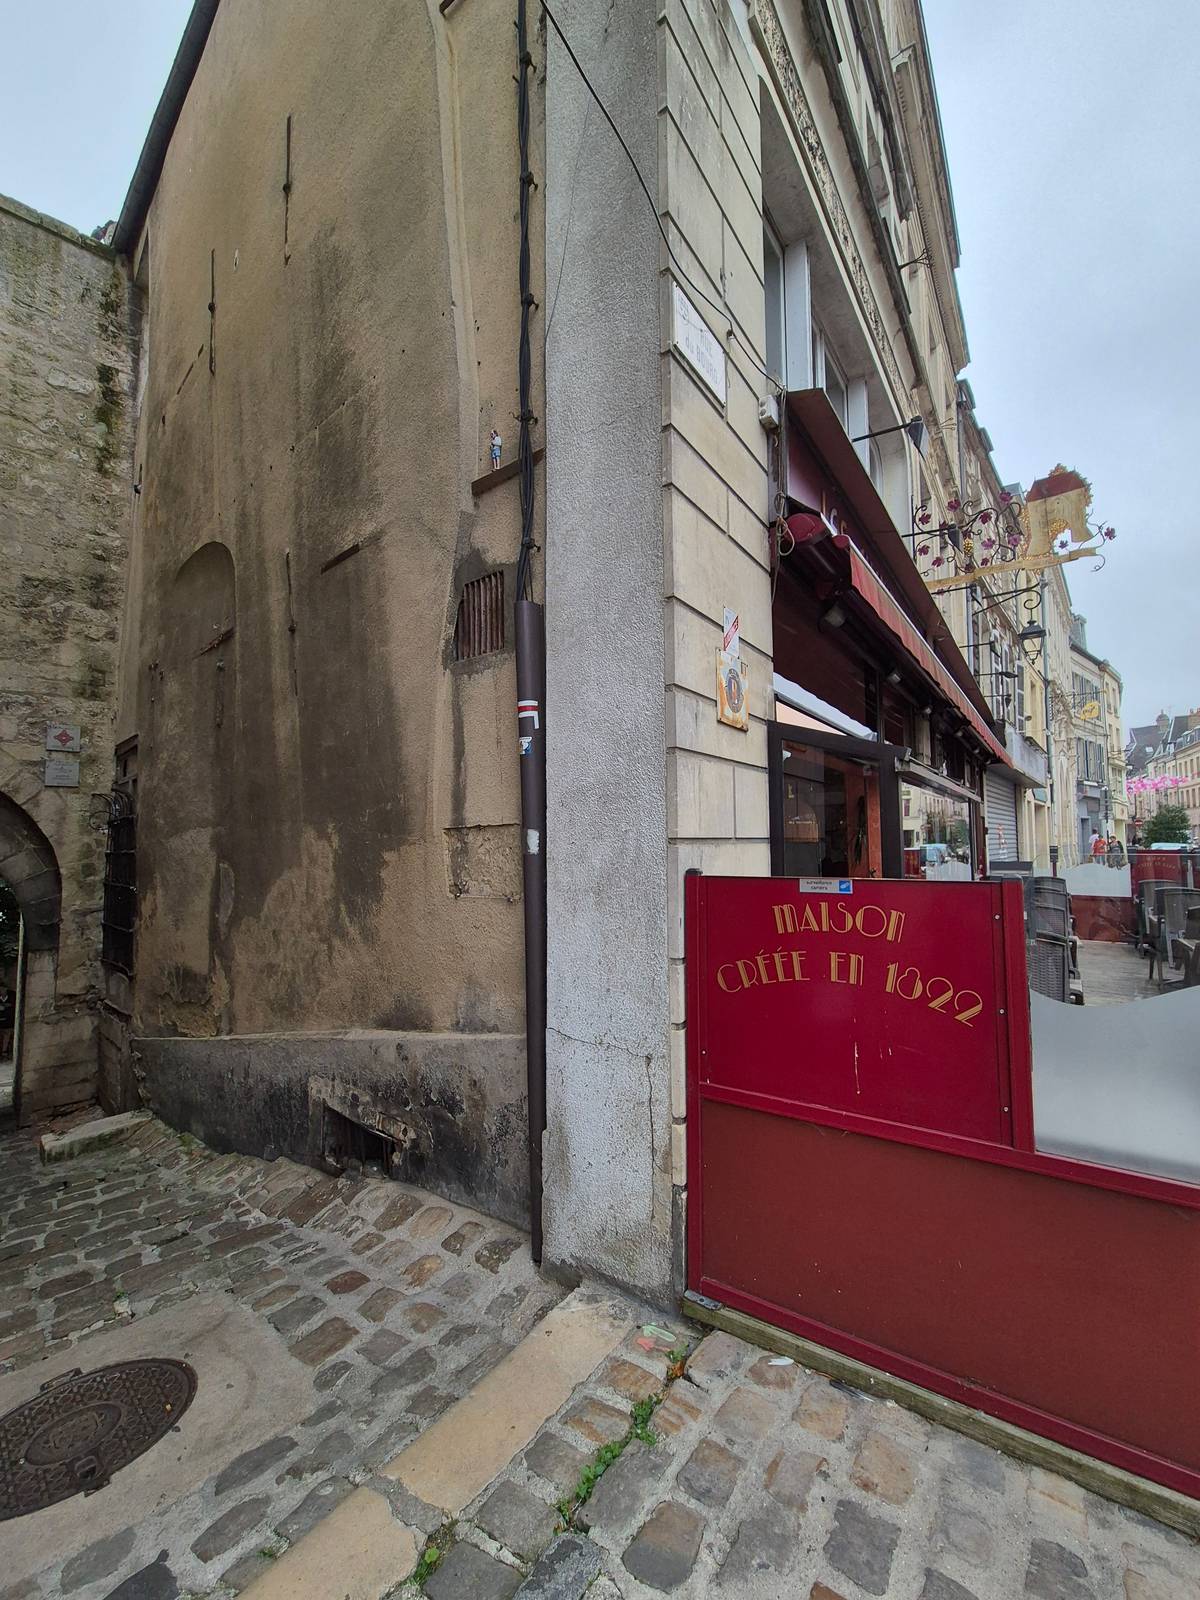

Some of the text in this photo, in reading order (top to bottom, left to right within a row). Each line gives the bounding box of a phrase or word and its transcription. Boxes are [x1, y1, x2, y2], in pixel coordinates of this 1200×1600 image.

[772, 902, 906, 943] MAISON
[717, 946, 983, 1027] CRÉÉE EN 1822
